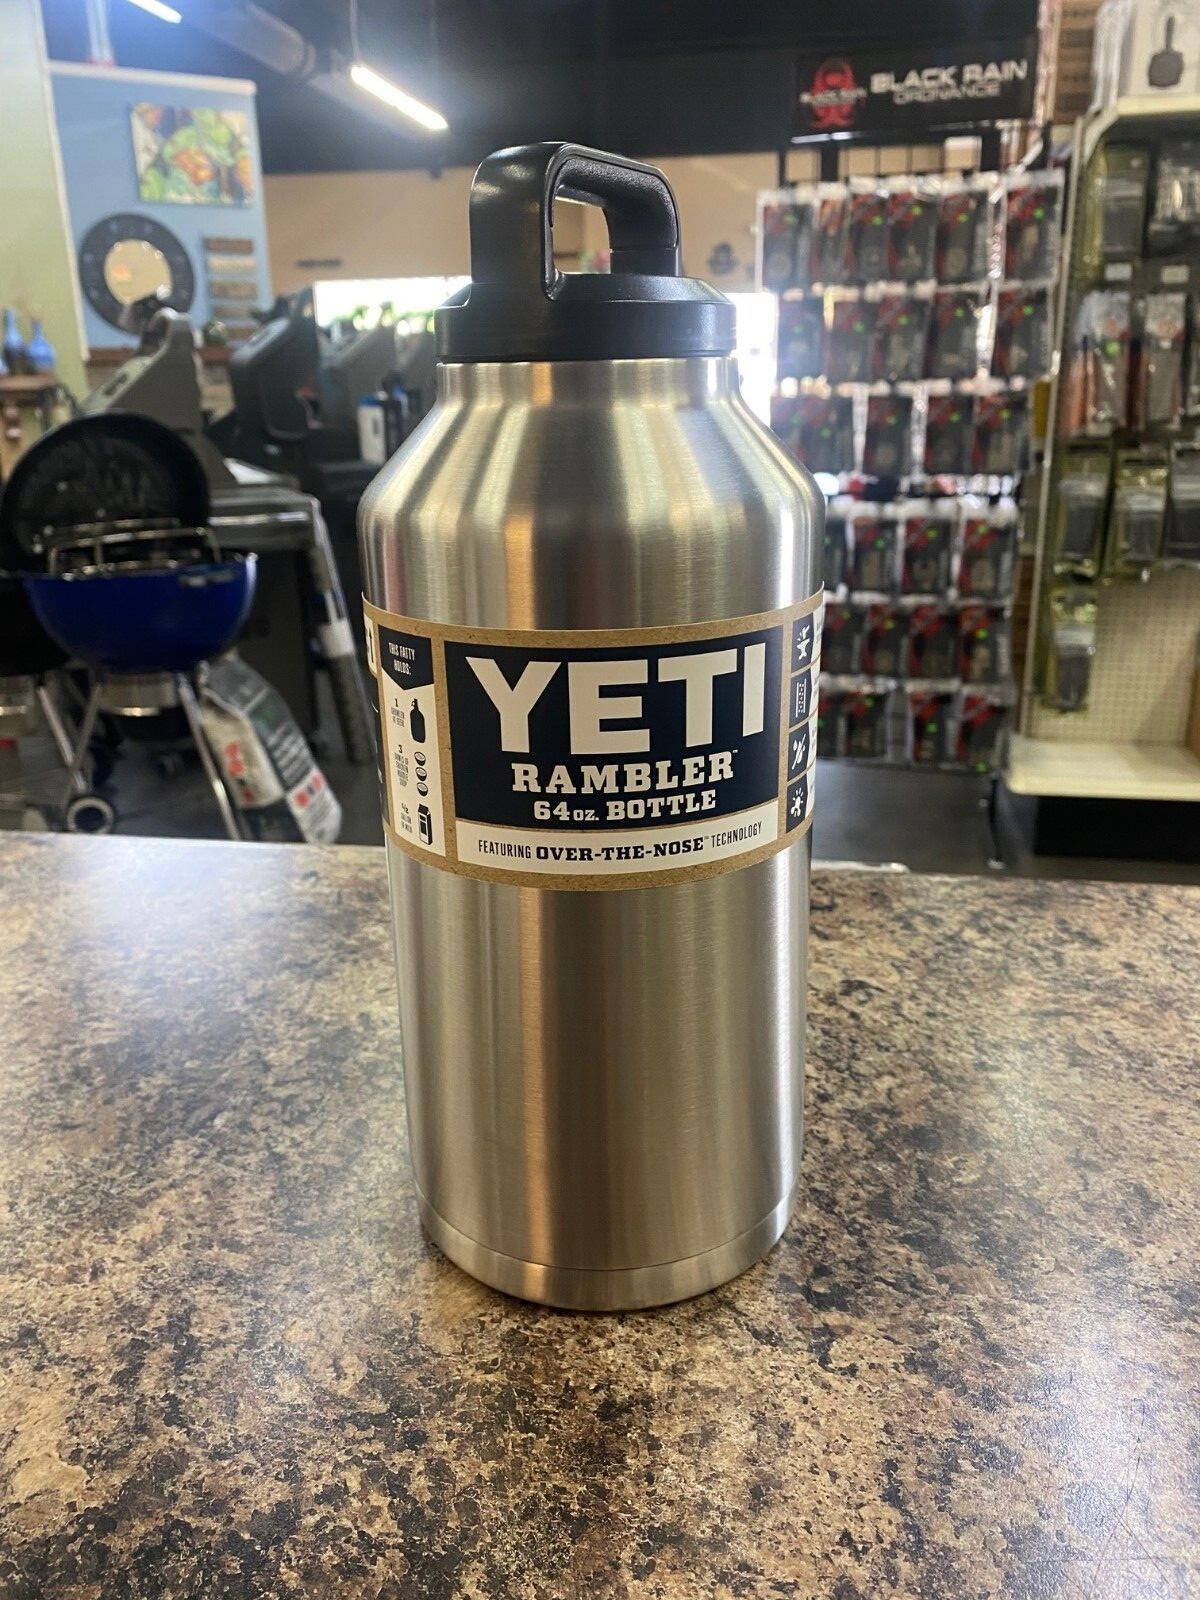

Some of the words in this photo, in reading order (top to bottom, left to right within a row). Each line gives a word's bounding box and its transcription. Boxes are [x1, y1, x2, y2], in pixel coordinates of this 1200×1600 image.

[870, 66, 957, 93] BLACK
[963, 59, 1028, 81] RAIN
[388, 642, 399, 657] THIS
[399, 645, 416, 661] FATTY
[465, 642, 766, 755] YETI
[606, 789, 716, 820] BOTTLE
[478, 839, 532, 859] FEATURING
[711, 821, 762, 848] TECHNOLOGY
